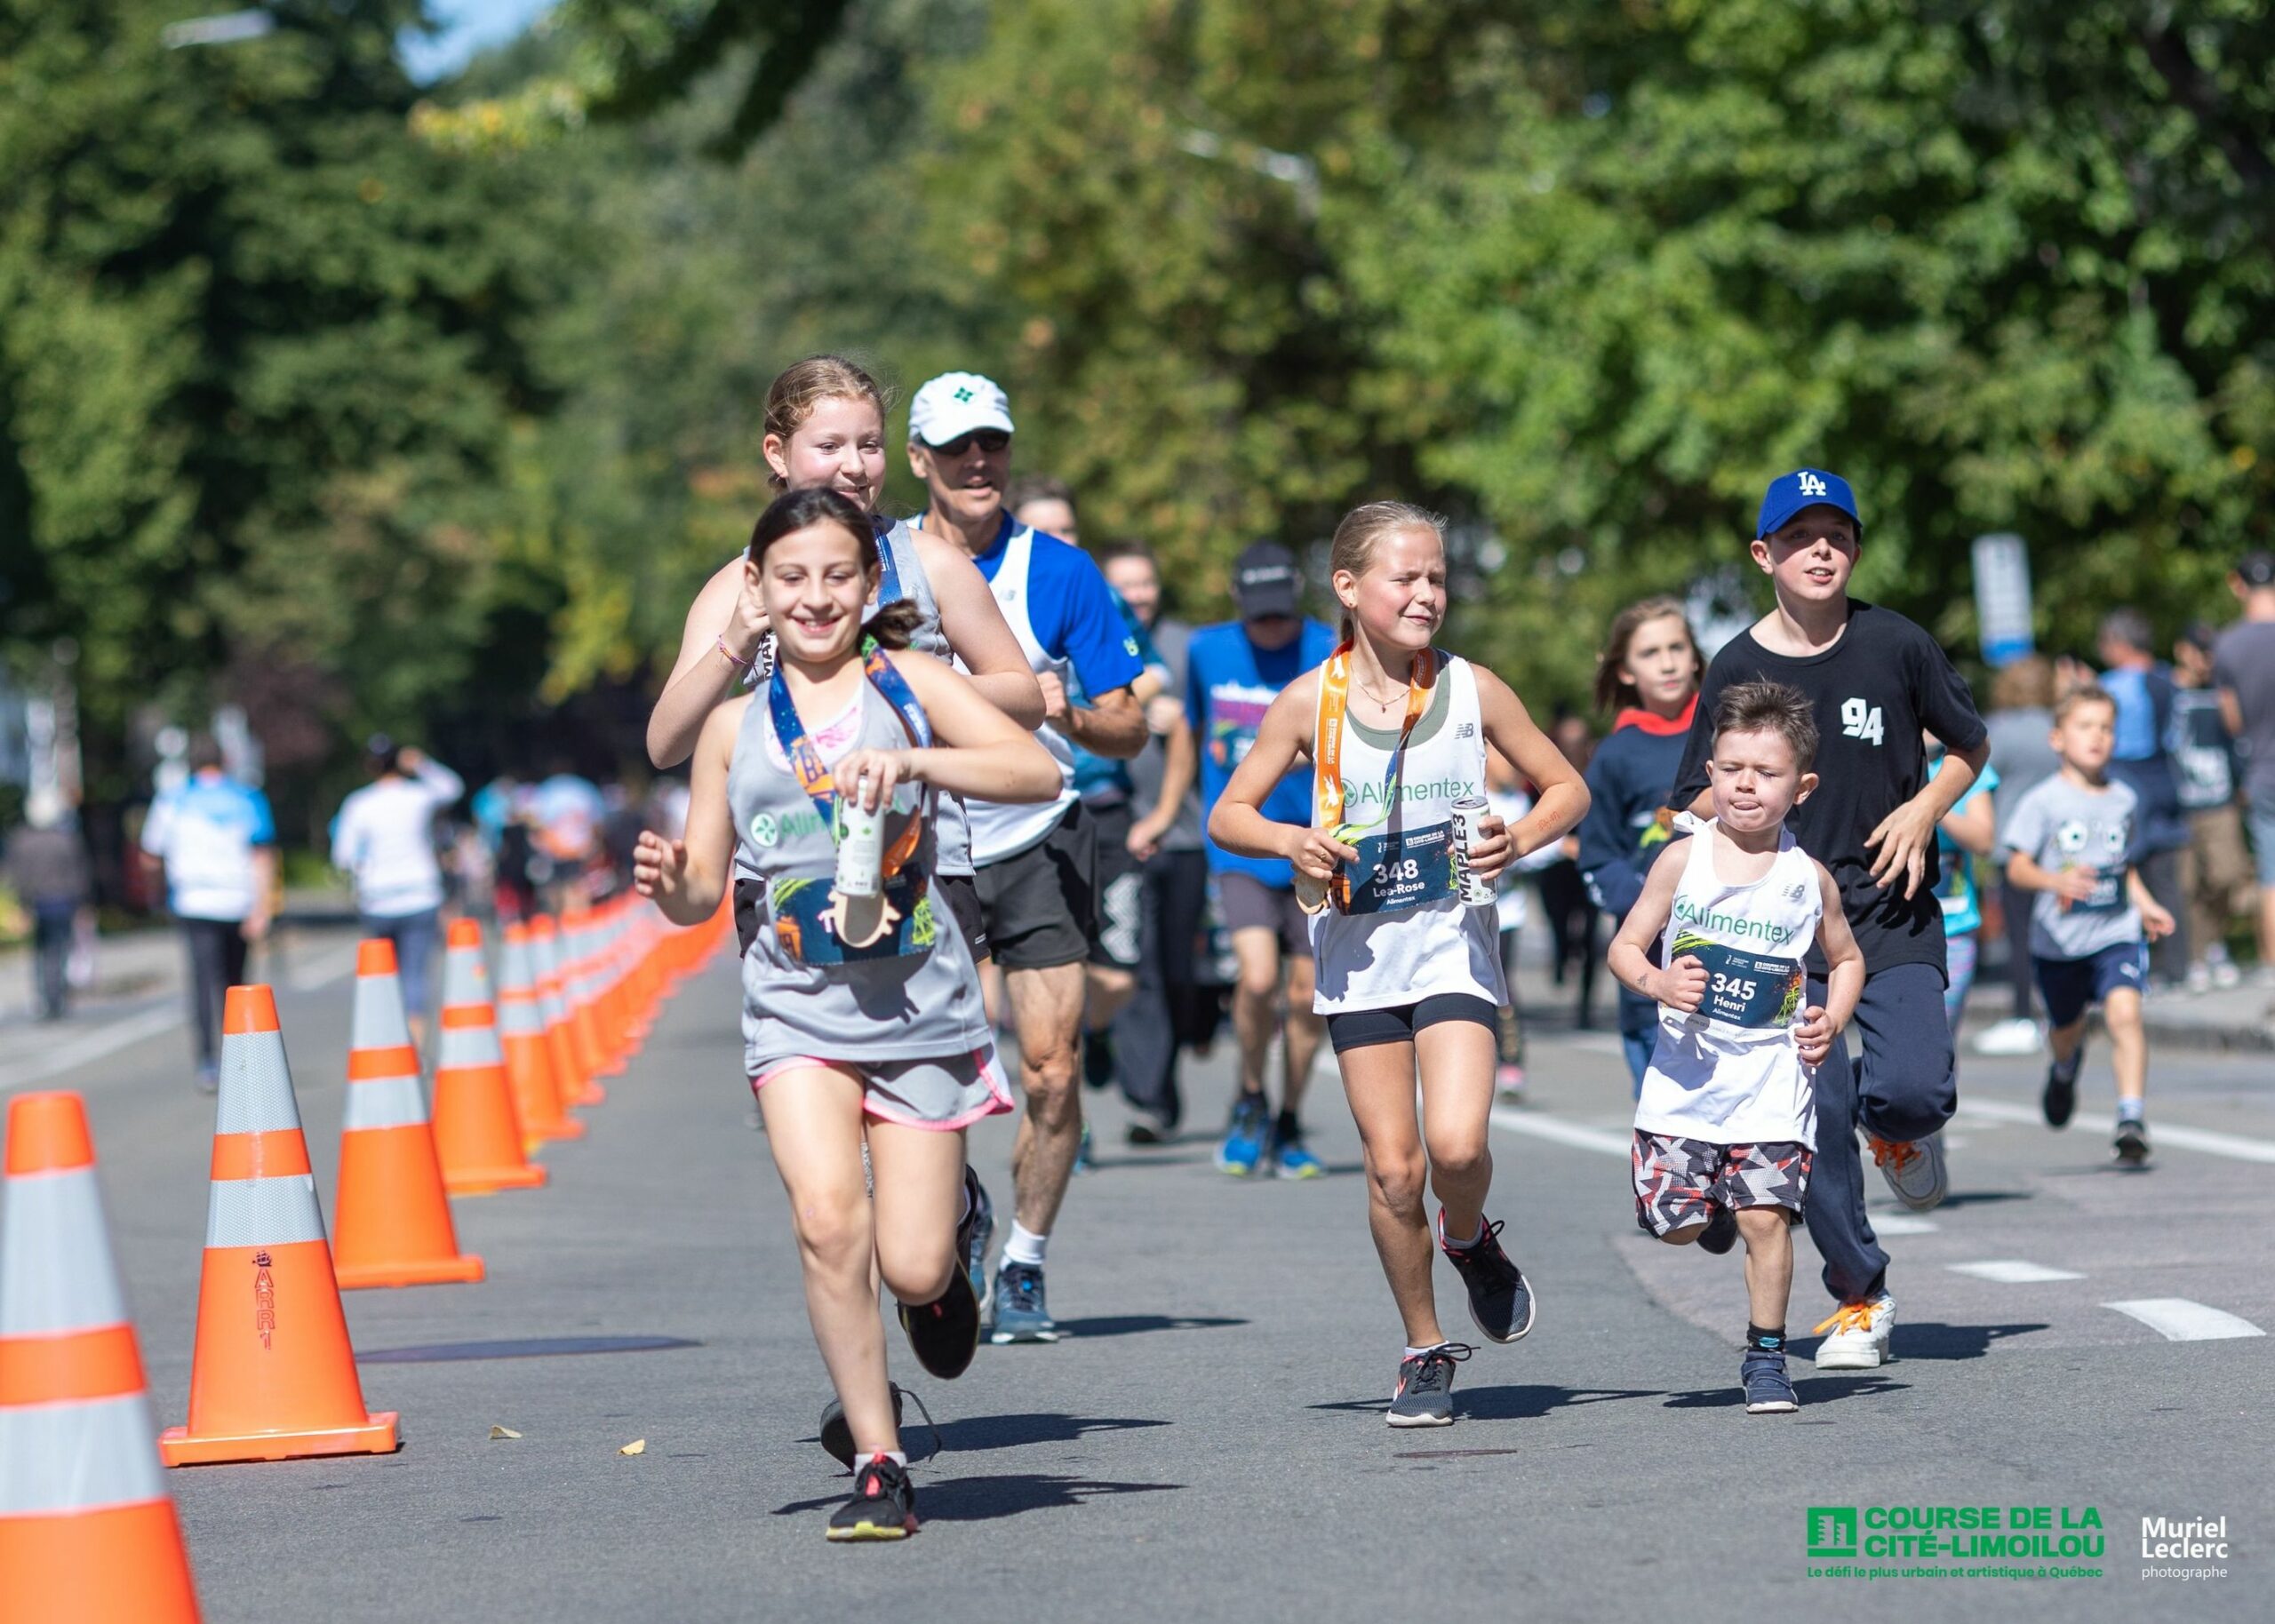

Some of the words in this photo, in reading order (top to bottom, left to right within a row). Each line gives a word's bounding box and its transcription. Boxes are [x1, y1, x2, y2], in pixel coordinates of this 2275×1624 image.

[1798, 471, 1826, 496] LA
[1841, 697, 1884, 746] 94
[1361, 777, 1474, 803] Almentex
[1373, 859, 1419, 884] 348
[1373, 880, 1425, 898] Lea-Rose
[1386, 896, 1416, 905] Alimentex
[1682, 904, 1794, 945] Alimentex
[1711, 973, 1758, 1001] 345
[1712, 1007, 1742, 1021] Alimentex
[1713, 995, 1746, 1013] Henri
